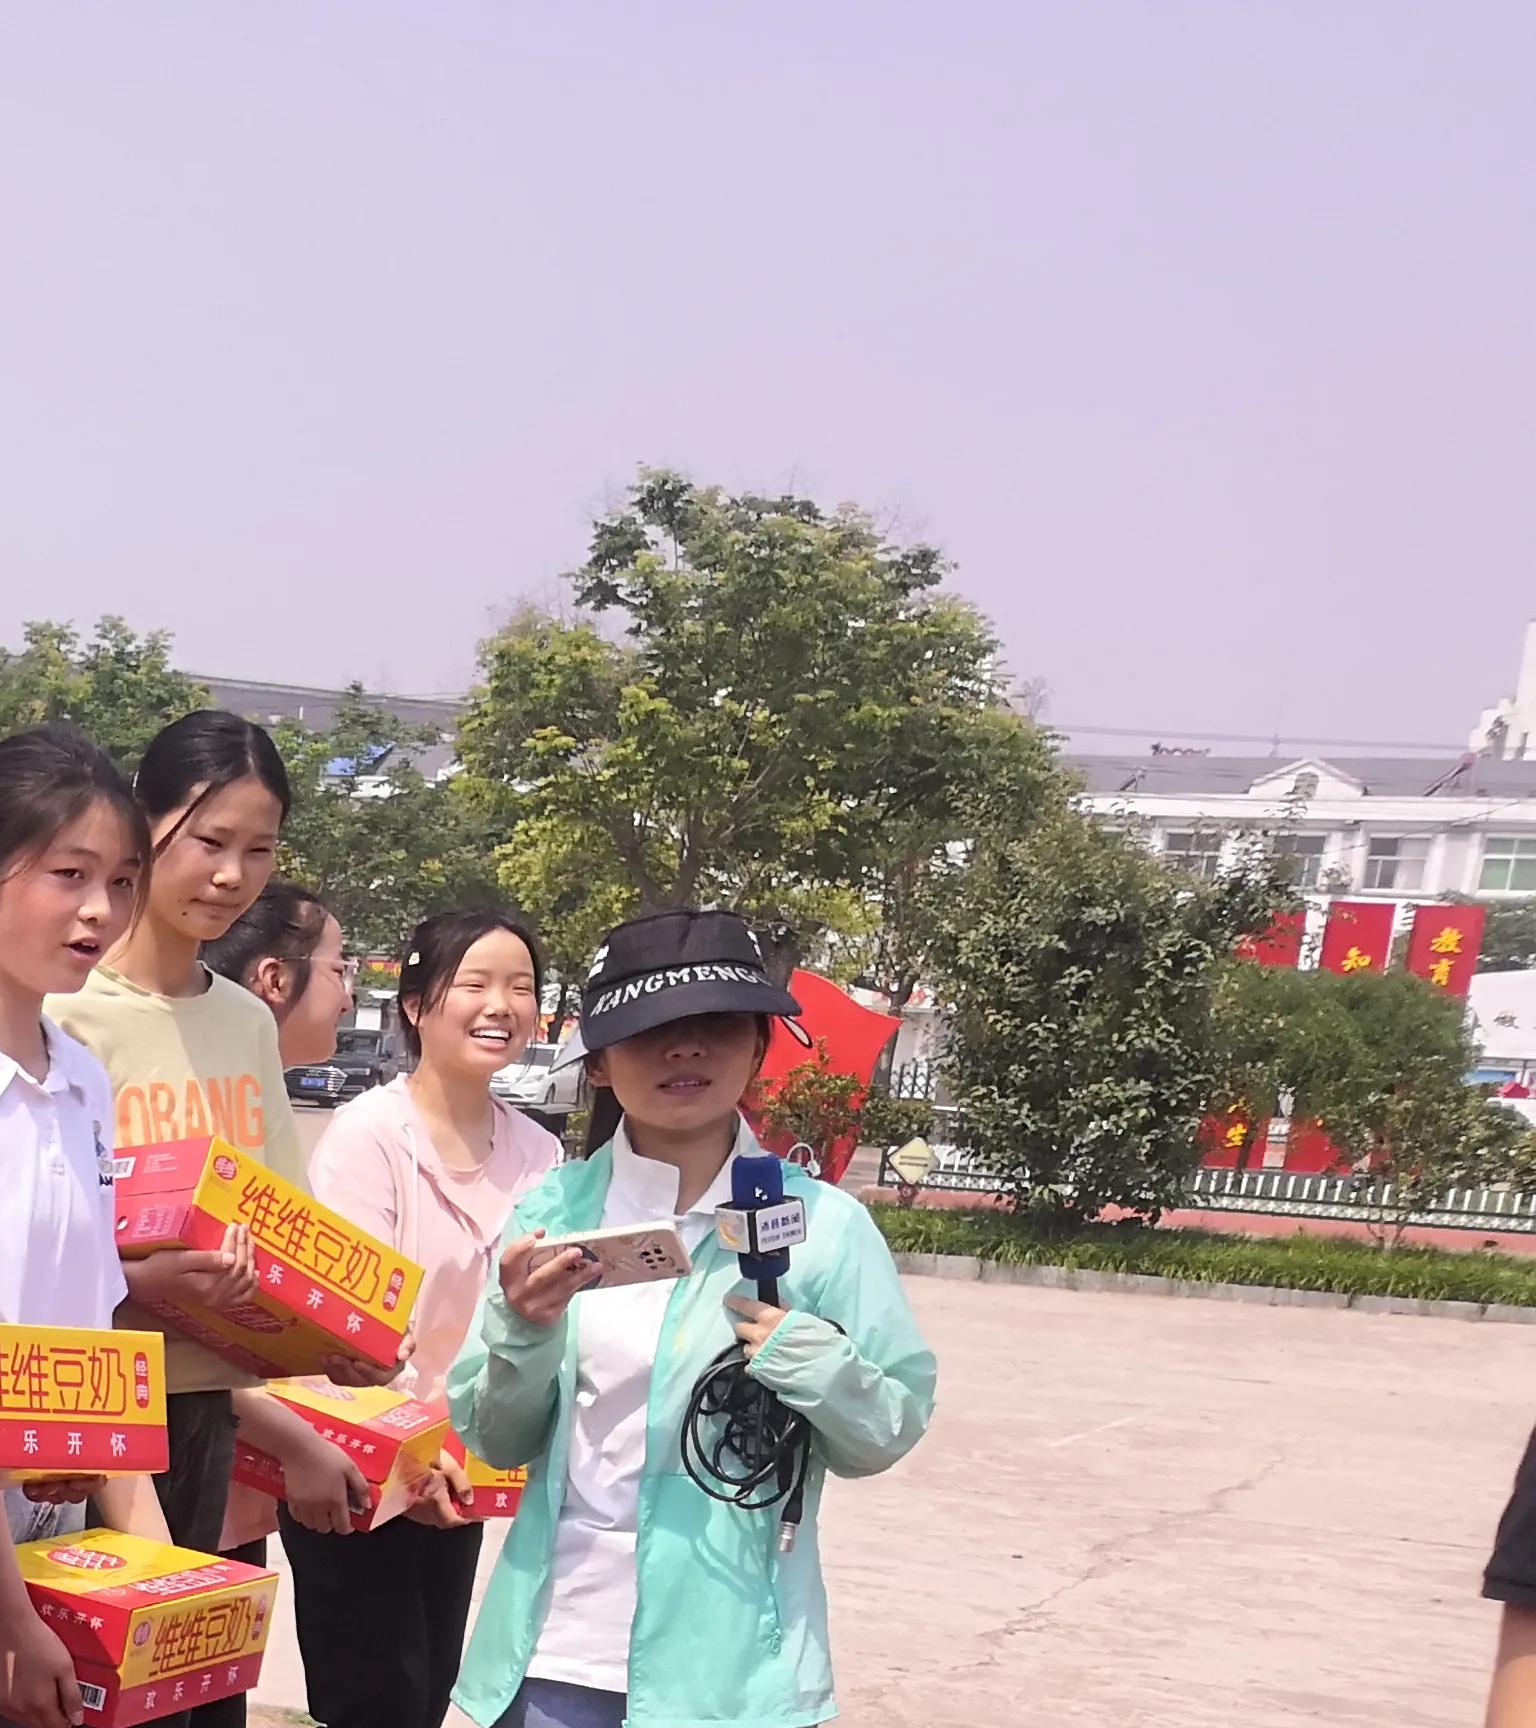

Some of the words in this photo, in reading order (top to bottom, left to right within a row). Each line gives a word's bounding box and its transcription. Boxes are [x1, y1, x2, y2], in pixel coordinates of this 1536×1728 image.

[1429, 927, 1464, 986] 教育
[232, 1175, 382, 1305] 维维豆奶
[266, 1263, 365, 1335] 乐开怀
[148, 1595, 253, 1679] 维维豆奶
